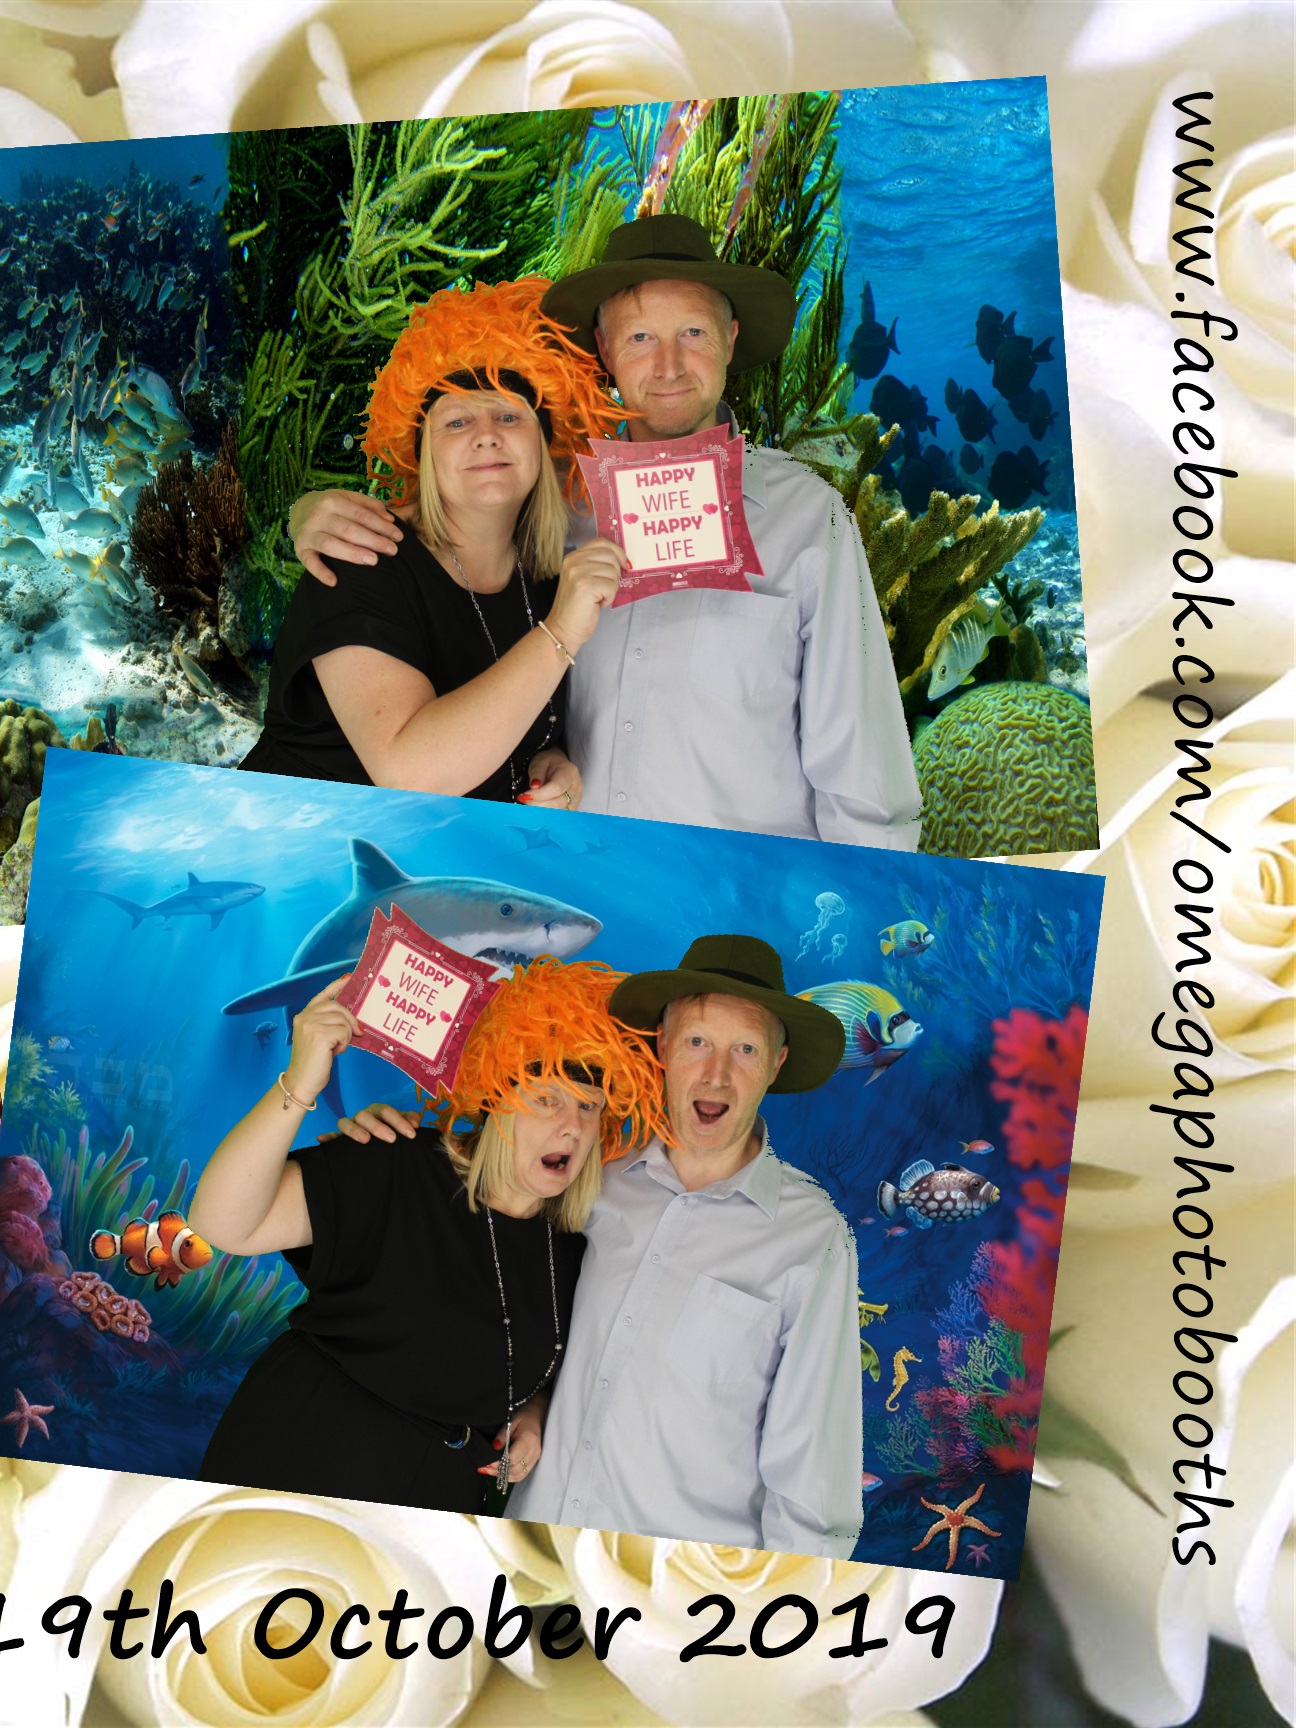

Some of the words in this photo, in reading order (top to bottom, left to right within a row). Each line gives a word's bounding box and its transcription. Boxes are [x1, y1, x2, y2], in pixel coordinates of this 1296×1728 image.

[635, 467, 696, 488] HAPPY
[641, 489, 691, 513] WIFE
[642, 515, 702, 536] HAPPY
[655, 538, 696, 562] LIFE
[404, 953, 454, 988] HAPPY
[399, 971, 439, 1006] WIFE
[385, 991, 436, 1026] HAPPY
[382, 1012, 419, 1043] LIFE
